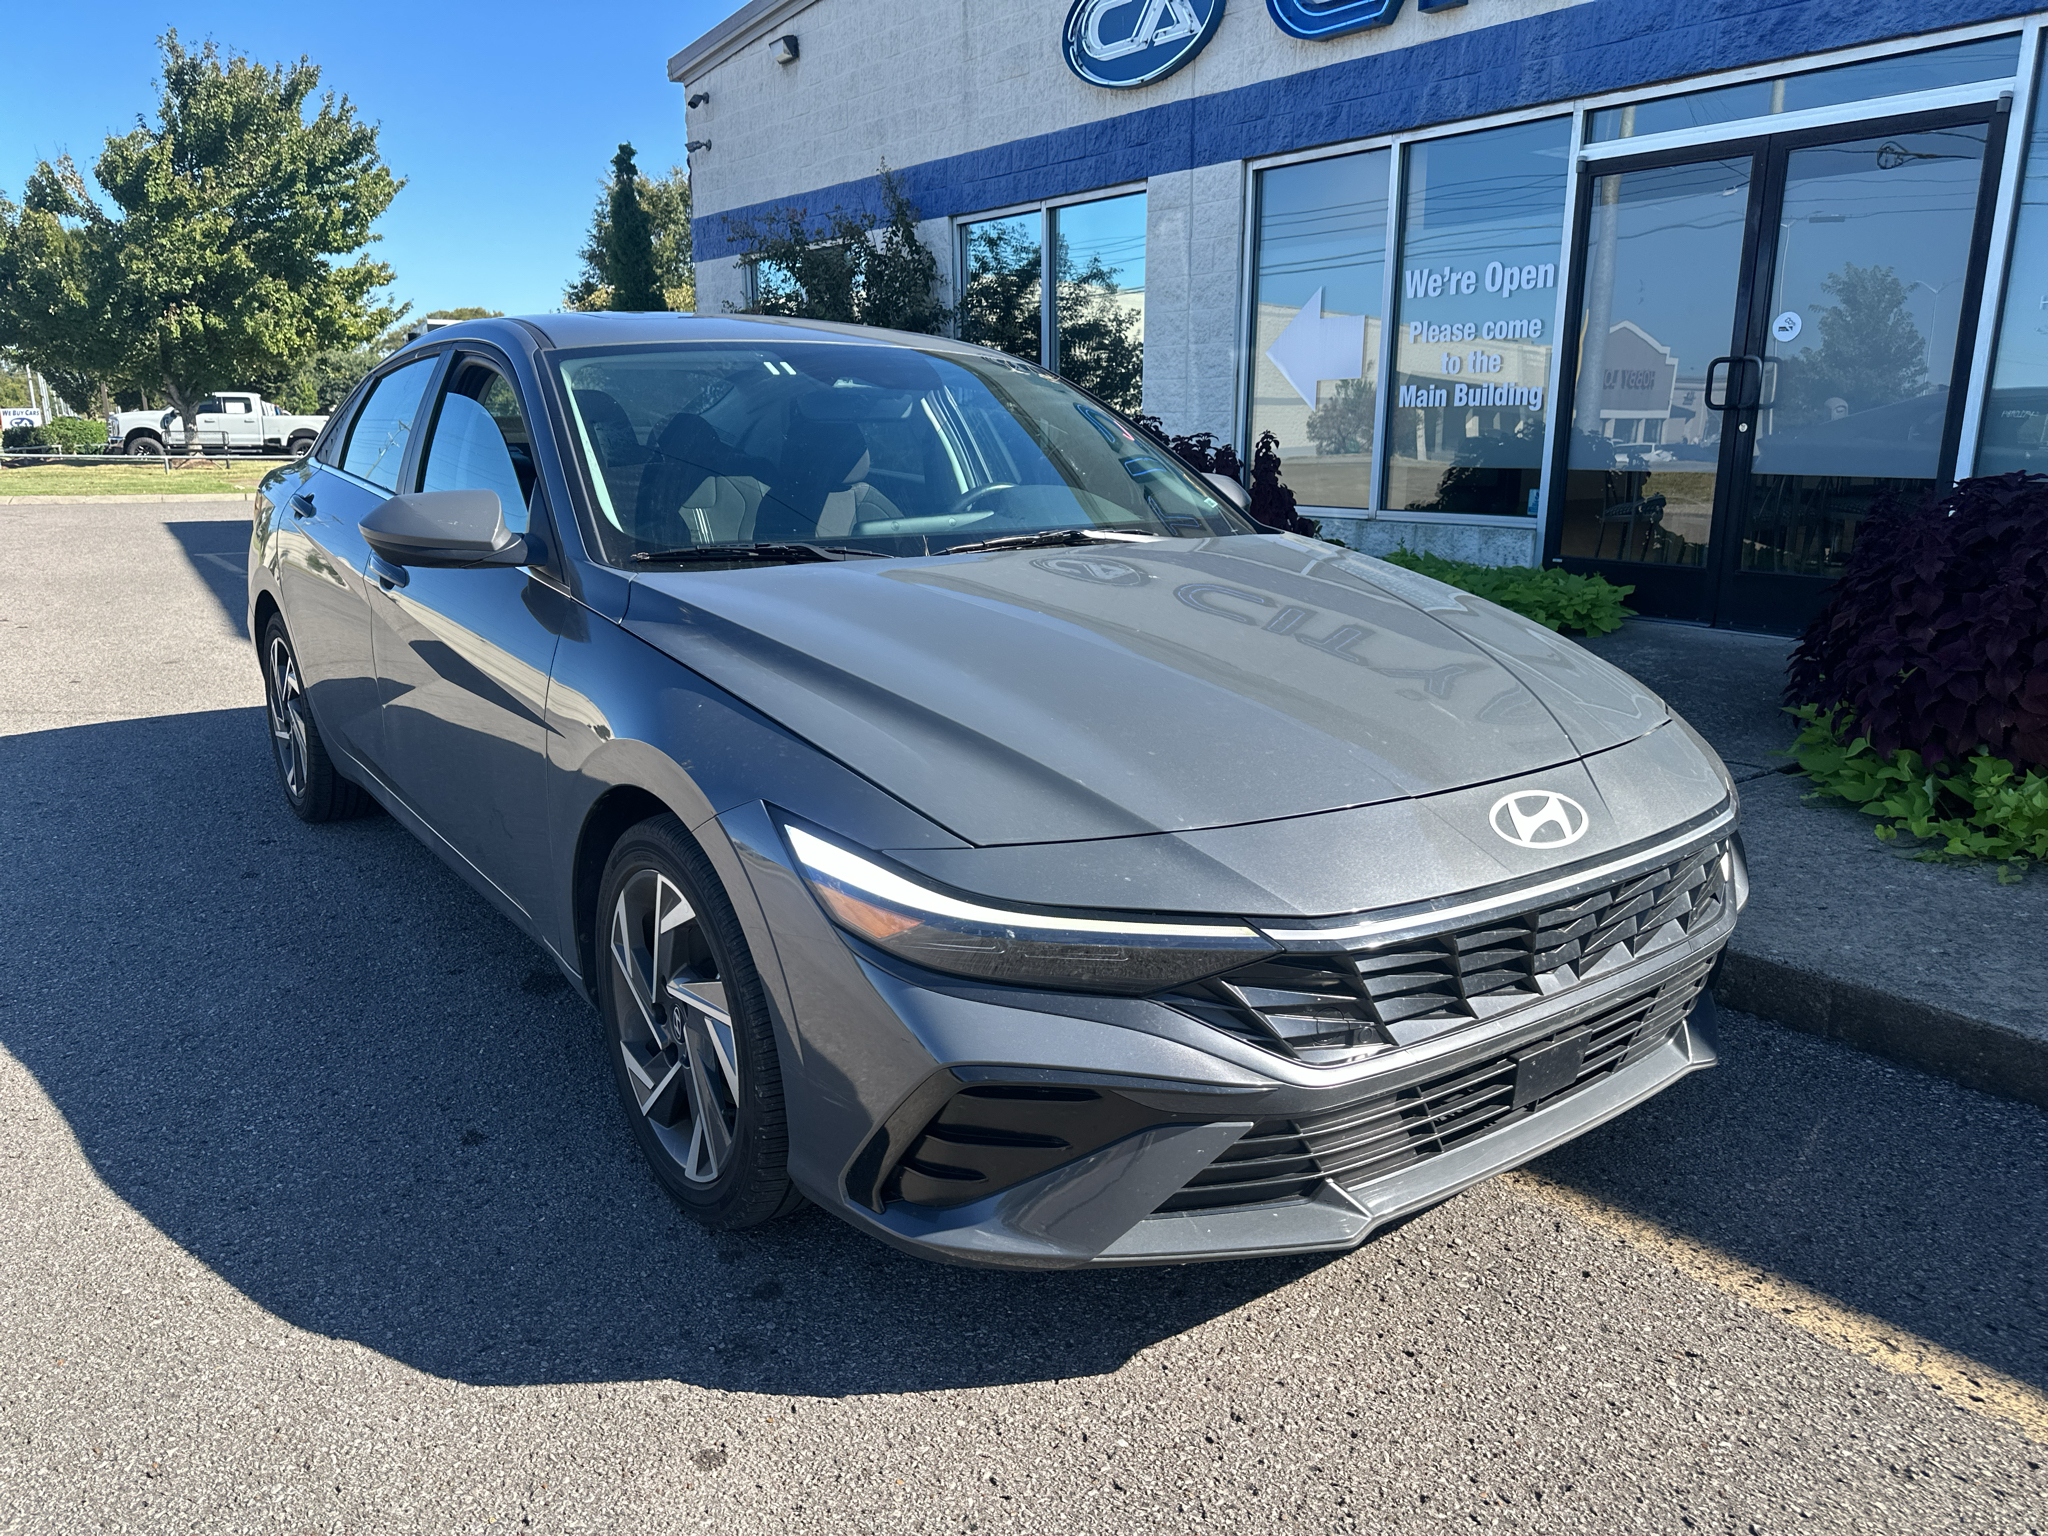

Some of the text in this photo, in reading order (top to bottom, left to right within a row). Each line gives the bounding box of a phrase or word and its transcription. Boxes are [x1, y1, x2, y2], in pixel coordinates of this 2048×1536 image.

[1405, 261, 1555, 299] We're Open
[1409, 318, 1542, 344] Please come
[1441, 352, 1461, 374] to
[1468, 350, 1502, 373] the
[1399, 382, 1543, 411] Main Building
